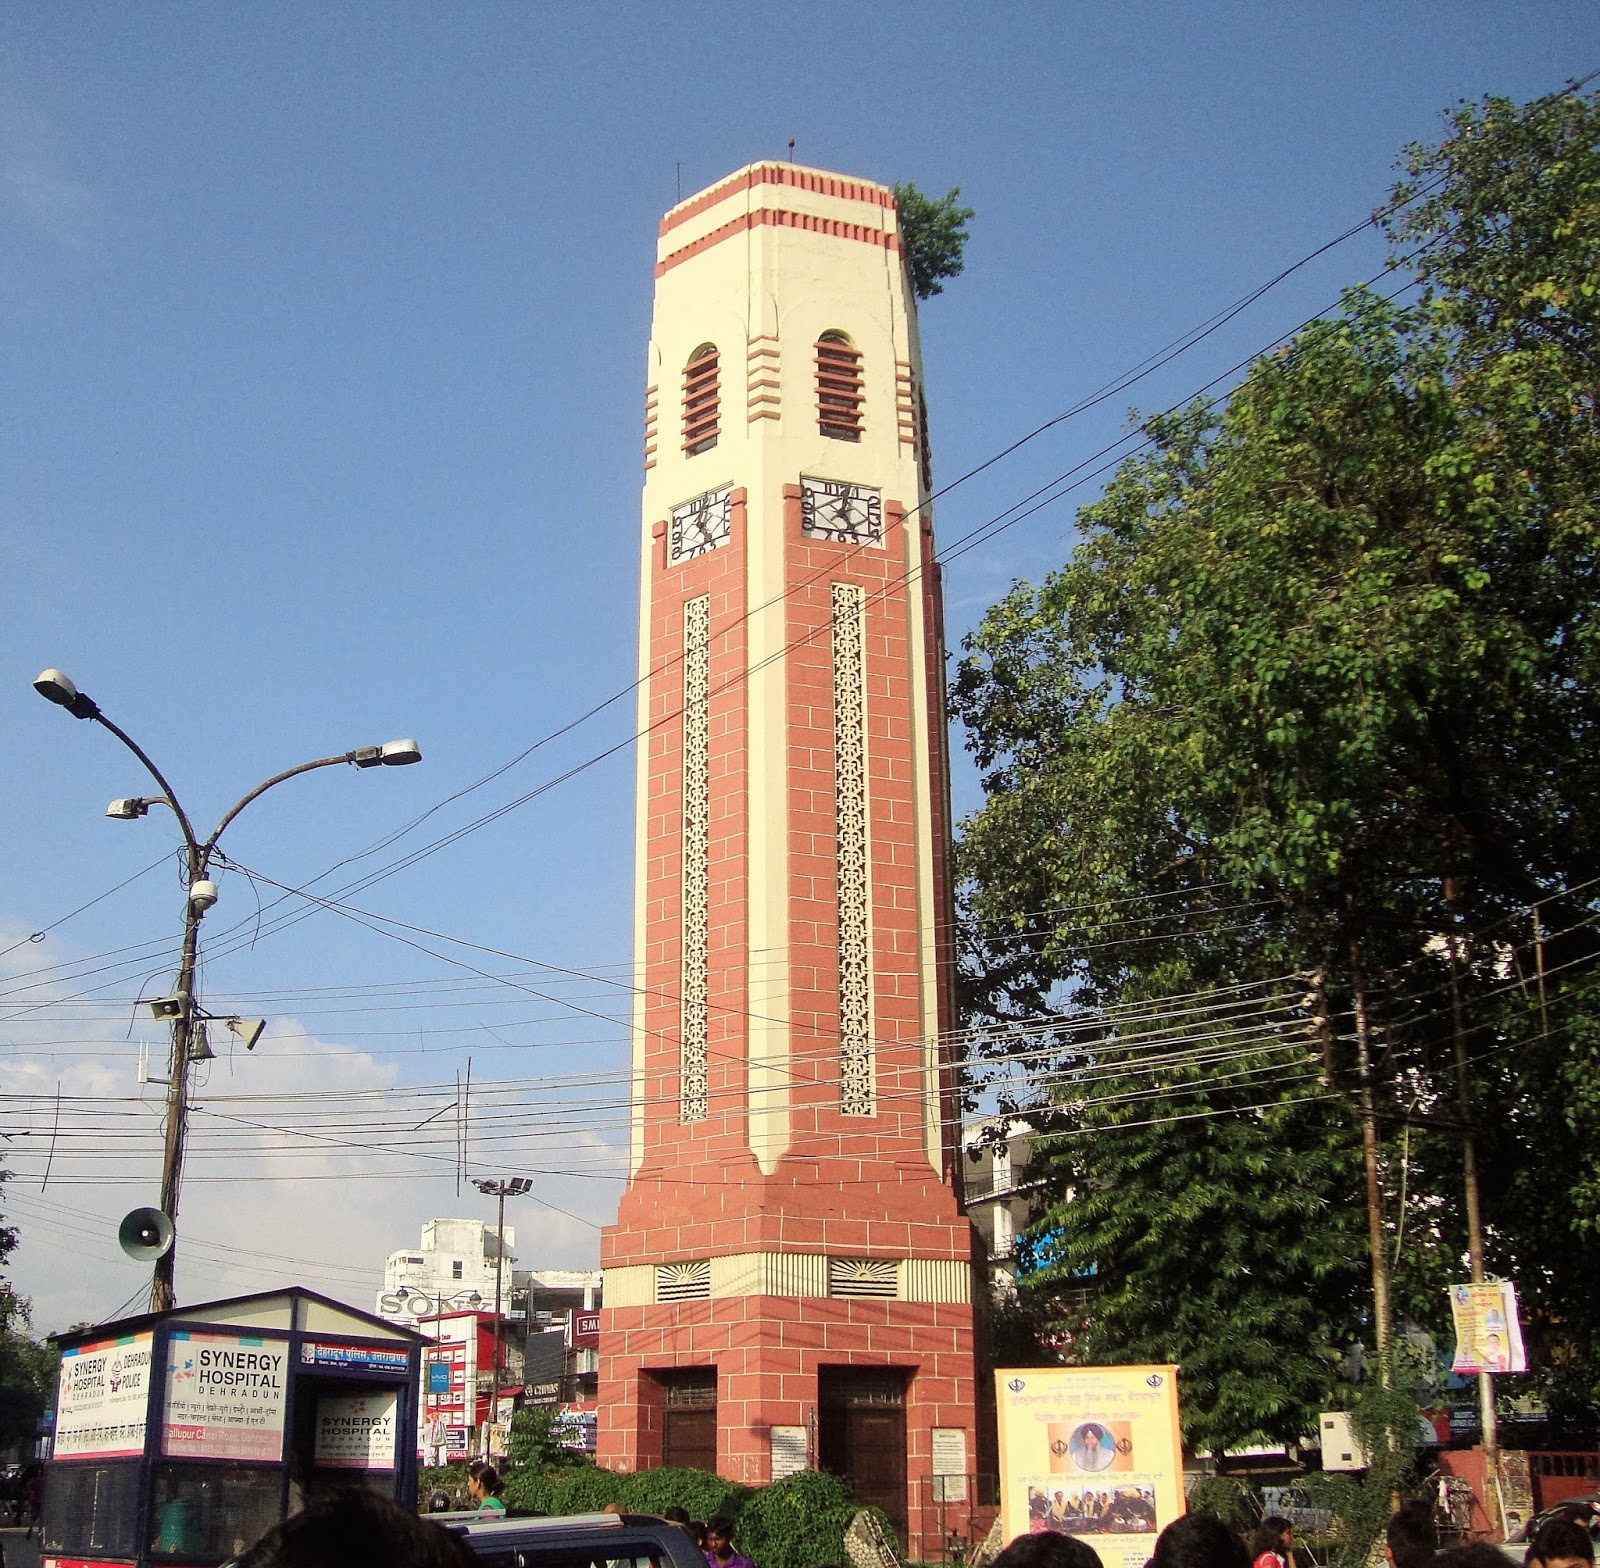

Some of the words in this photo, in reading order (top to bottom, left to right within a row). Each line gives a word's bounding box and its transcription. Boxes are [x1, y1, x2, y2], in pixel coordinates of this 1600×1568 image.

[74, 1357, 107, 1377] SYNERGY
[123, 1350, 152, 1369] DEHRADUN
[200, 1349, 282, 1371] SYNERGY
[73, 1375, 105, 1391] HOSPITAL
[122, 1373, 141, 1390] POLICE
[199, 1370, 281, 1388] HOSPITAL
[198, 1386, 280, 1399] DEHRADUN
[322, 1417, 391, 1426] SYNERGY
